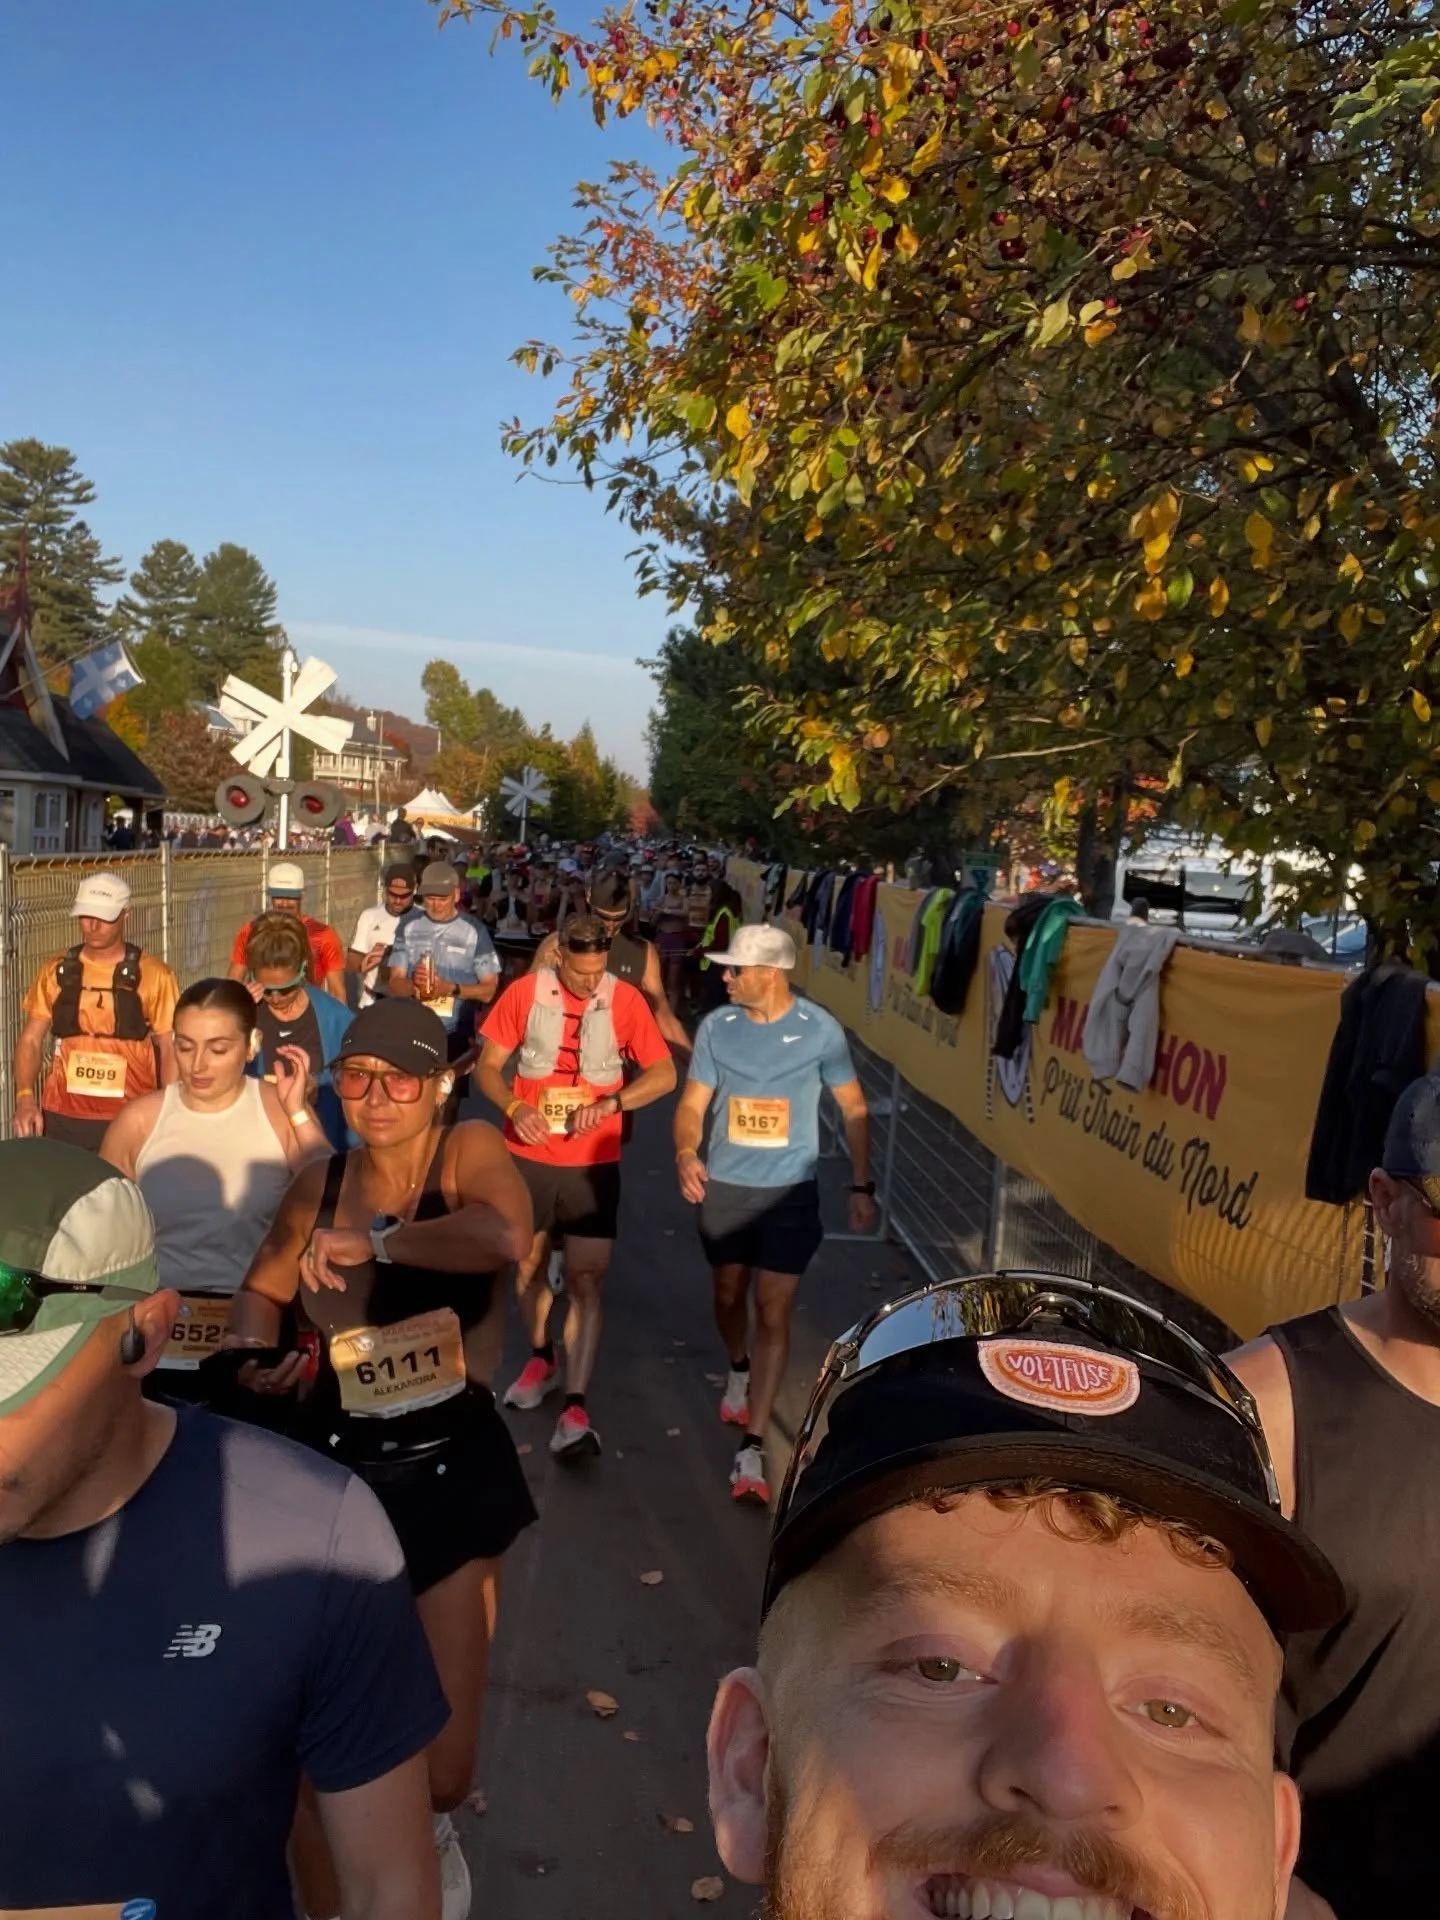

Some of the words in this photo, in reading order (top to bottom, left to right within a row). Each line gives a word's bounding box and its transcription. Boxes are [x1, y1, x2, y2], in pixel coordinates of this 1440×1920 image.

[1050, 996, 1227, 1121] MAHON
[76, 1067, 116, 1080] 6099
[737, 1114, 779, 1128] 6167
[1083, 1076, 1142, 1161] Train
[1143, 1121, 1175, 1181] du
[1180, 1136, 1259, 1231] Nord
[171, 1324, 229, 1343] 652
[356, 1346, 440, 1385] 6111
[1008, 1355, 1109, 1391] VOLTFUSE
[374, 1373, 437, 1396] ALEXANDRA
